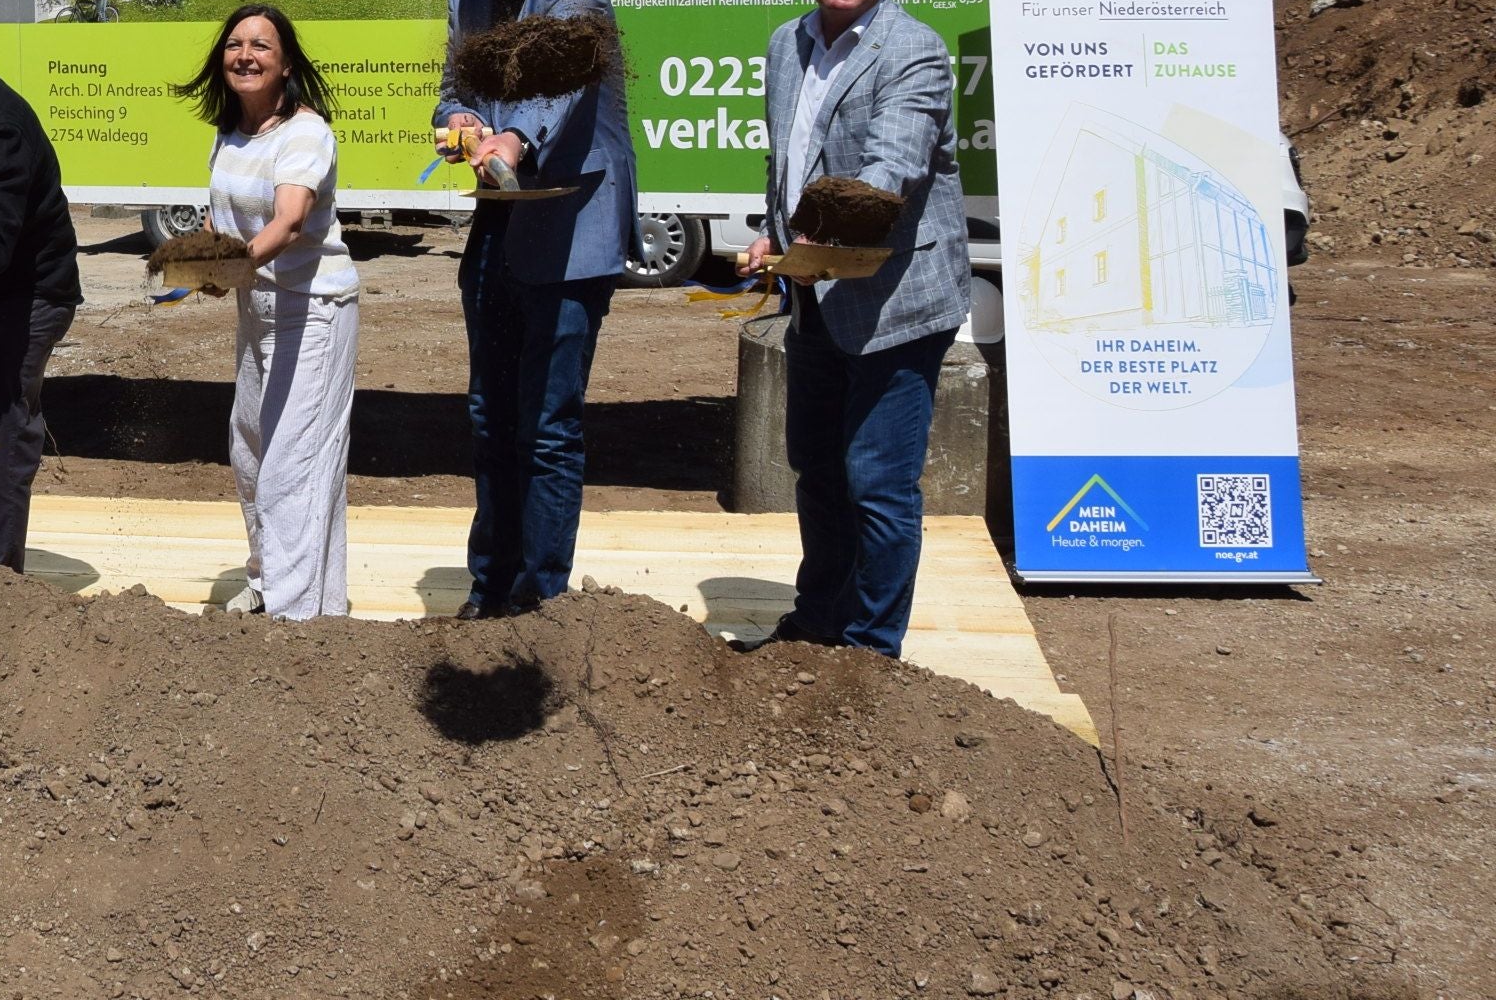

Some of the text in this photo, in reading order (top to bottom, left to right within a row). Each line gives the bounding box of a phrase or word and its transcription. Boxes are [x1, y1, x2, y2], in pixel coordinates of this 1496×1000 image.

[1022, 2, 1226, 16] Für unser Niederösterreich
[1024, 42, 1107, 56] VON UNS
[1154, 42, 1188, 54] DAS
[48, 61, 107, 77] Planung
[315, 60, 444, 73] Generalunterneh
[1026, 61, 1133, 78] GEFÖRDERT
[1154, 65, 1236, 77] ZUHAUSE
[660, 55, 766, 97] 0223
[49, 83, 84, 97] Arch.
[88, 83, 102, 97] DI
[106, 82, 163, 97] Andreas
[388, 83, 440, 97] Schaffe
[50, 106, 127, 122] Peisching 9
[642, 108, 768, 149] verka
[50, 128, 148, 146] 2754 Waldegg
[352, 130, 393, 144] Markt
[398, 131, 435, 144] Piest
[1096, 340, 1200, 352] IHR DAHEIM.
[1081, 361, 1218, 373] DER BESTE PLATZ
[1110, 382, 1191, 394] DER WELT.
[1079, 507, 1115, 518] MEIN
[1070, 521, 1126, 532] DAHEIM
[1052, 536, 1087, 548] Heute
[1101, 537, 1144, 550] morgen.
[1215, 551, 1258, 562] noe.gv.at
